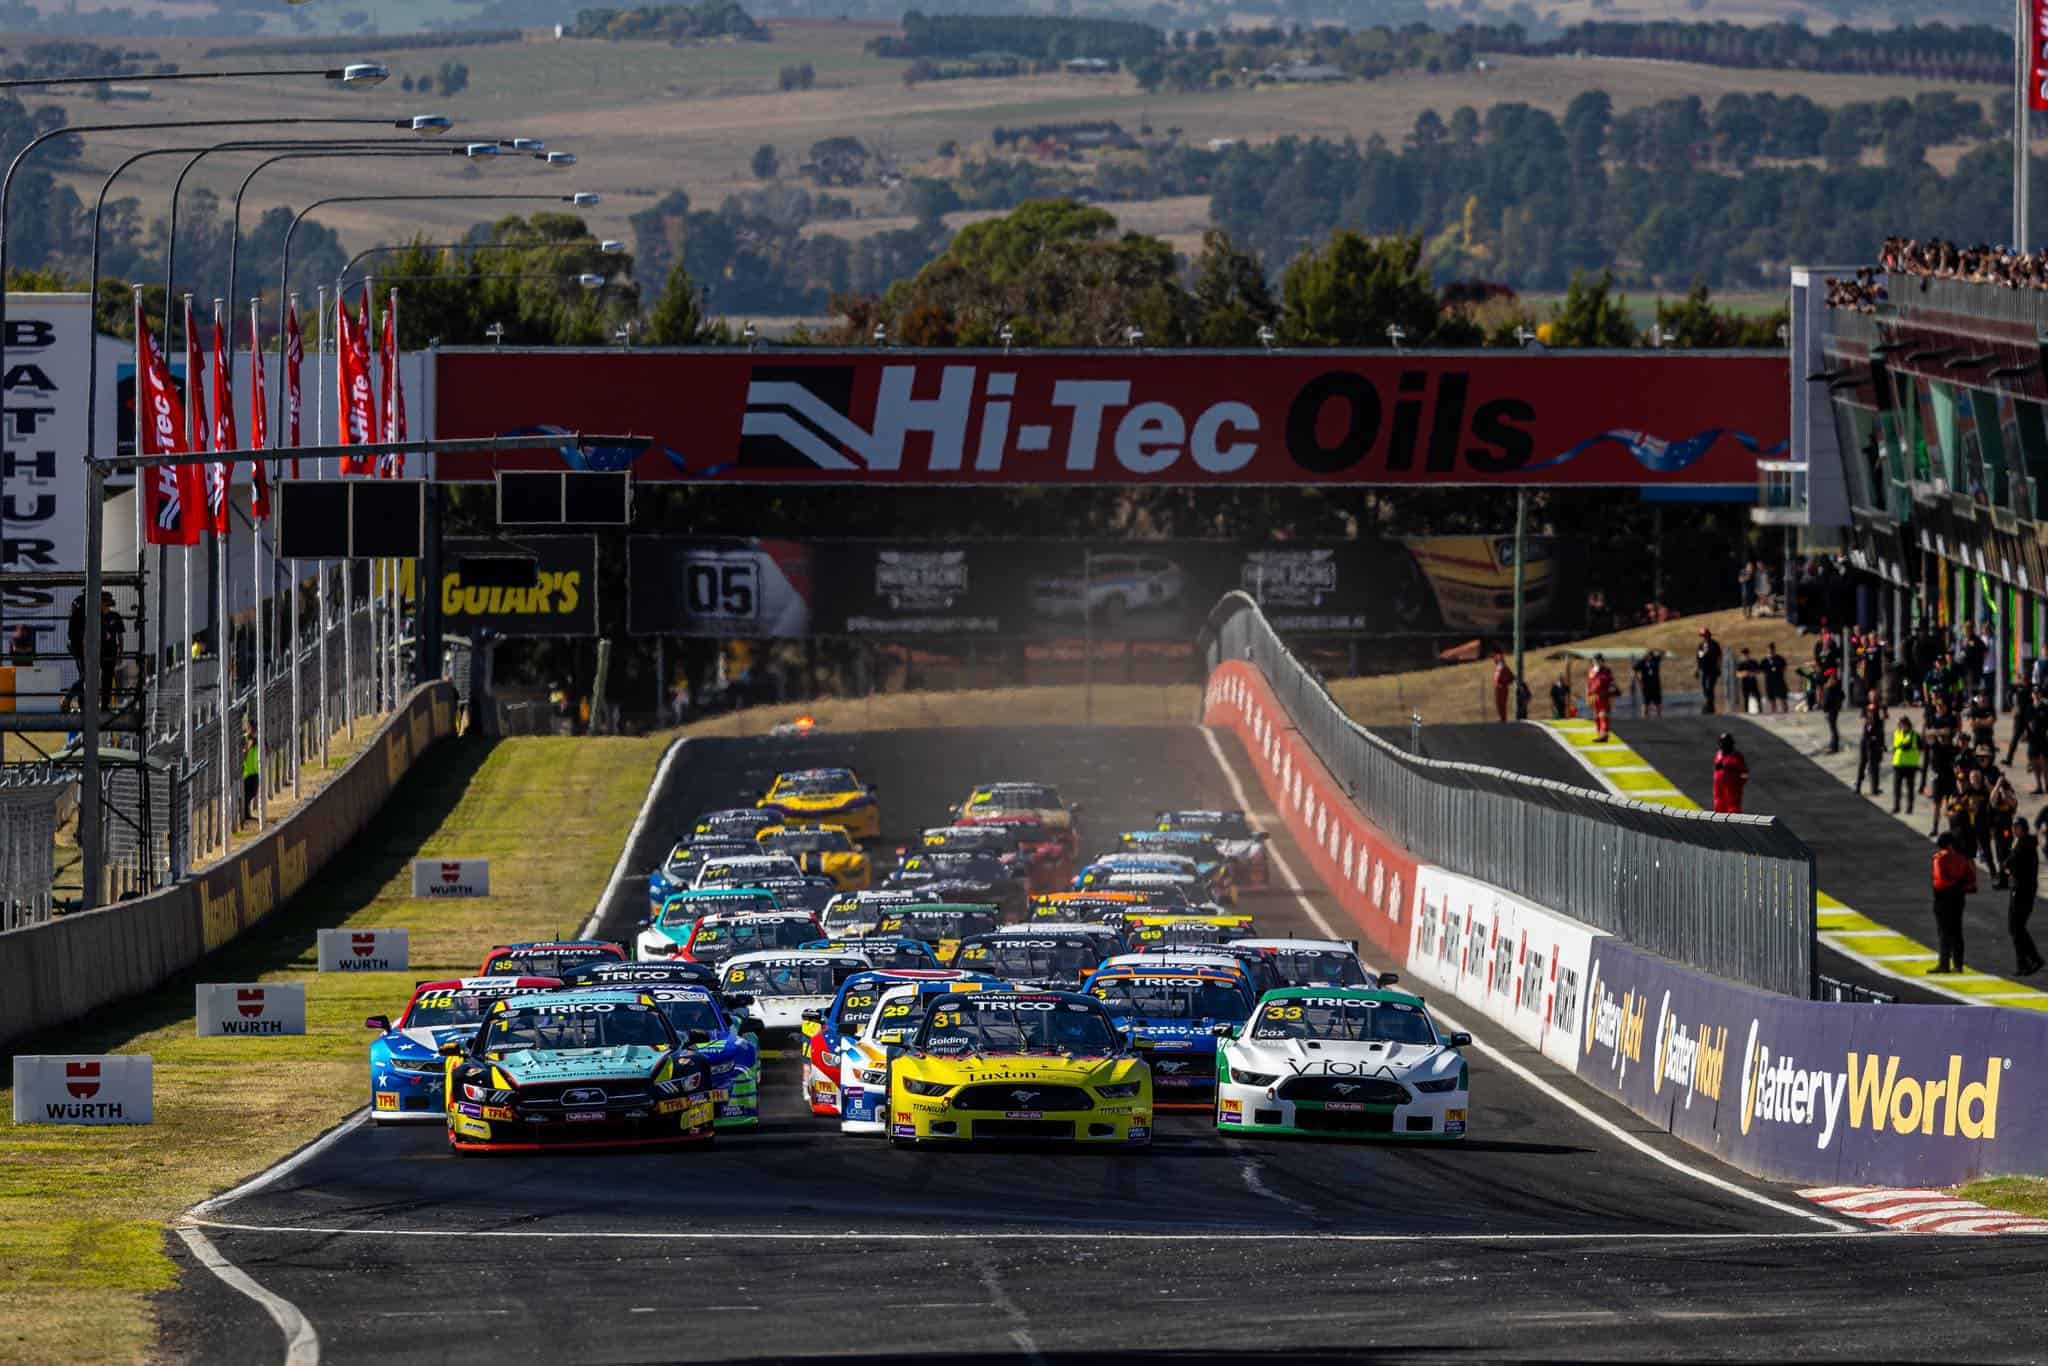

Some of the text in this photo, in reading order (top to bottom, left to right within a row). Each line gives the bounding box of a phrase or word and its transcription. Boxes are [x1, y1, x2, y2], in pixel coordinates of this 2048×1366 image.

[868, 366, 1536, 473] Hi-Tec Oils
[688, 566, 753, 615] 05
[730, 917, 784, 926] TRICO
[696, 931, 717, 941] 23
[992, 940, 1056, 948] TRICO
[1278, 948, 1321, 957] RICO
[761, 958, 829, 968] TRICO
[598, 971, 670, 981] TRICO
[730, 970, 745, 983] 8
[1131, 978, 1204, 987] TRICO
[420, 998, 452, 1009] 118
[847, 996, 872, 1008] 03
[973, 1002, 1057, 1011] TRICO
[1301, 998, 1381, 1008] TRICO
[534, 1003, 616, 1015] TRICO
[884, 1006, 910, 1017] 29
[1267, 1007, 1304, 1020] 33
[934, 1013, 961, 1027] 31
[222, 1019, 282, 1034] WÜRTH
[496, 1020, 509, 1032] 1
[1257, 1029, 1287, 1038] Cox
[928, 1036, 968, 1046] Golding
[969, 1071, 1037, 1082] Luxton
[47, 1102, 123, 1119] WÜRTH
[913, 1103, 949, 1113] TITANIUM
